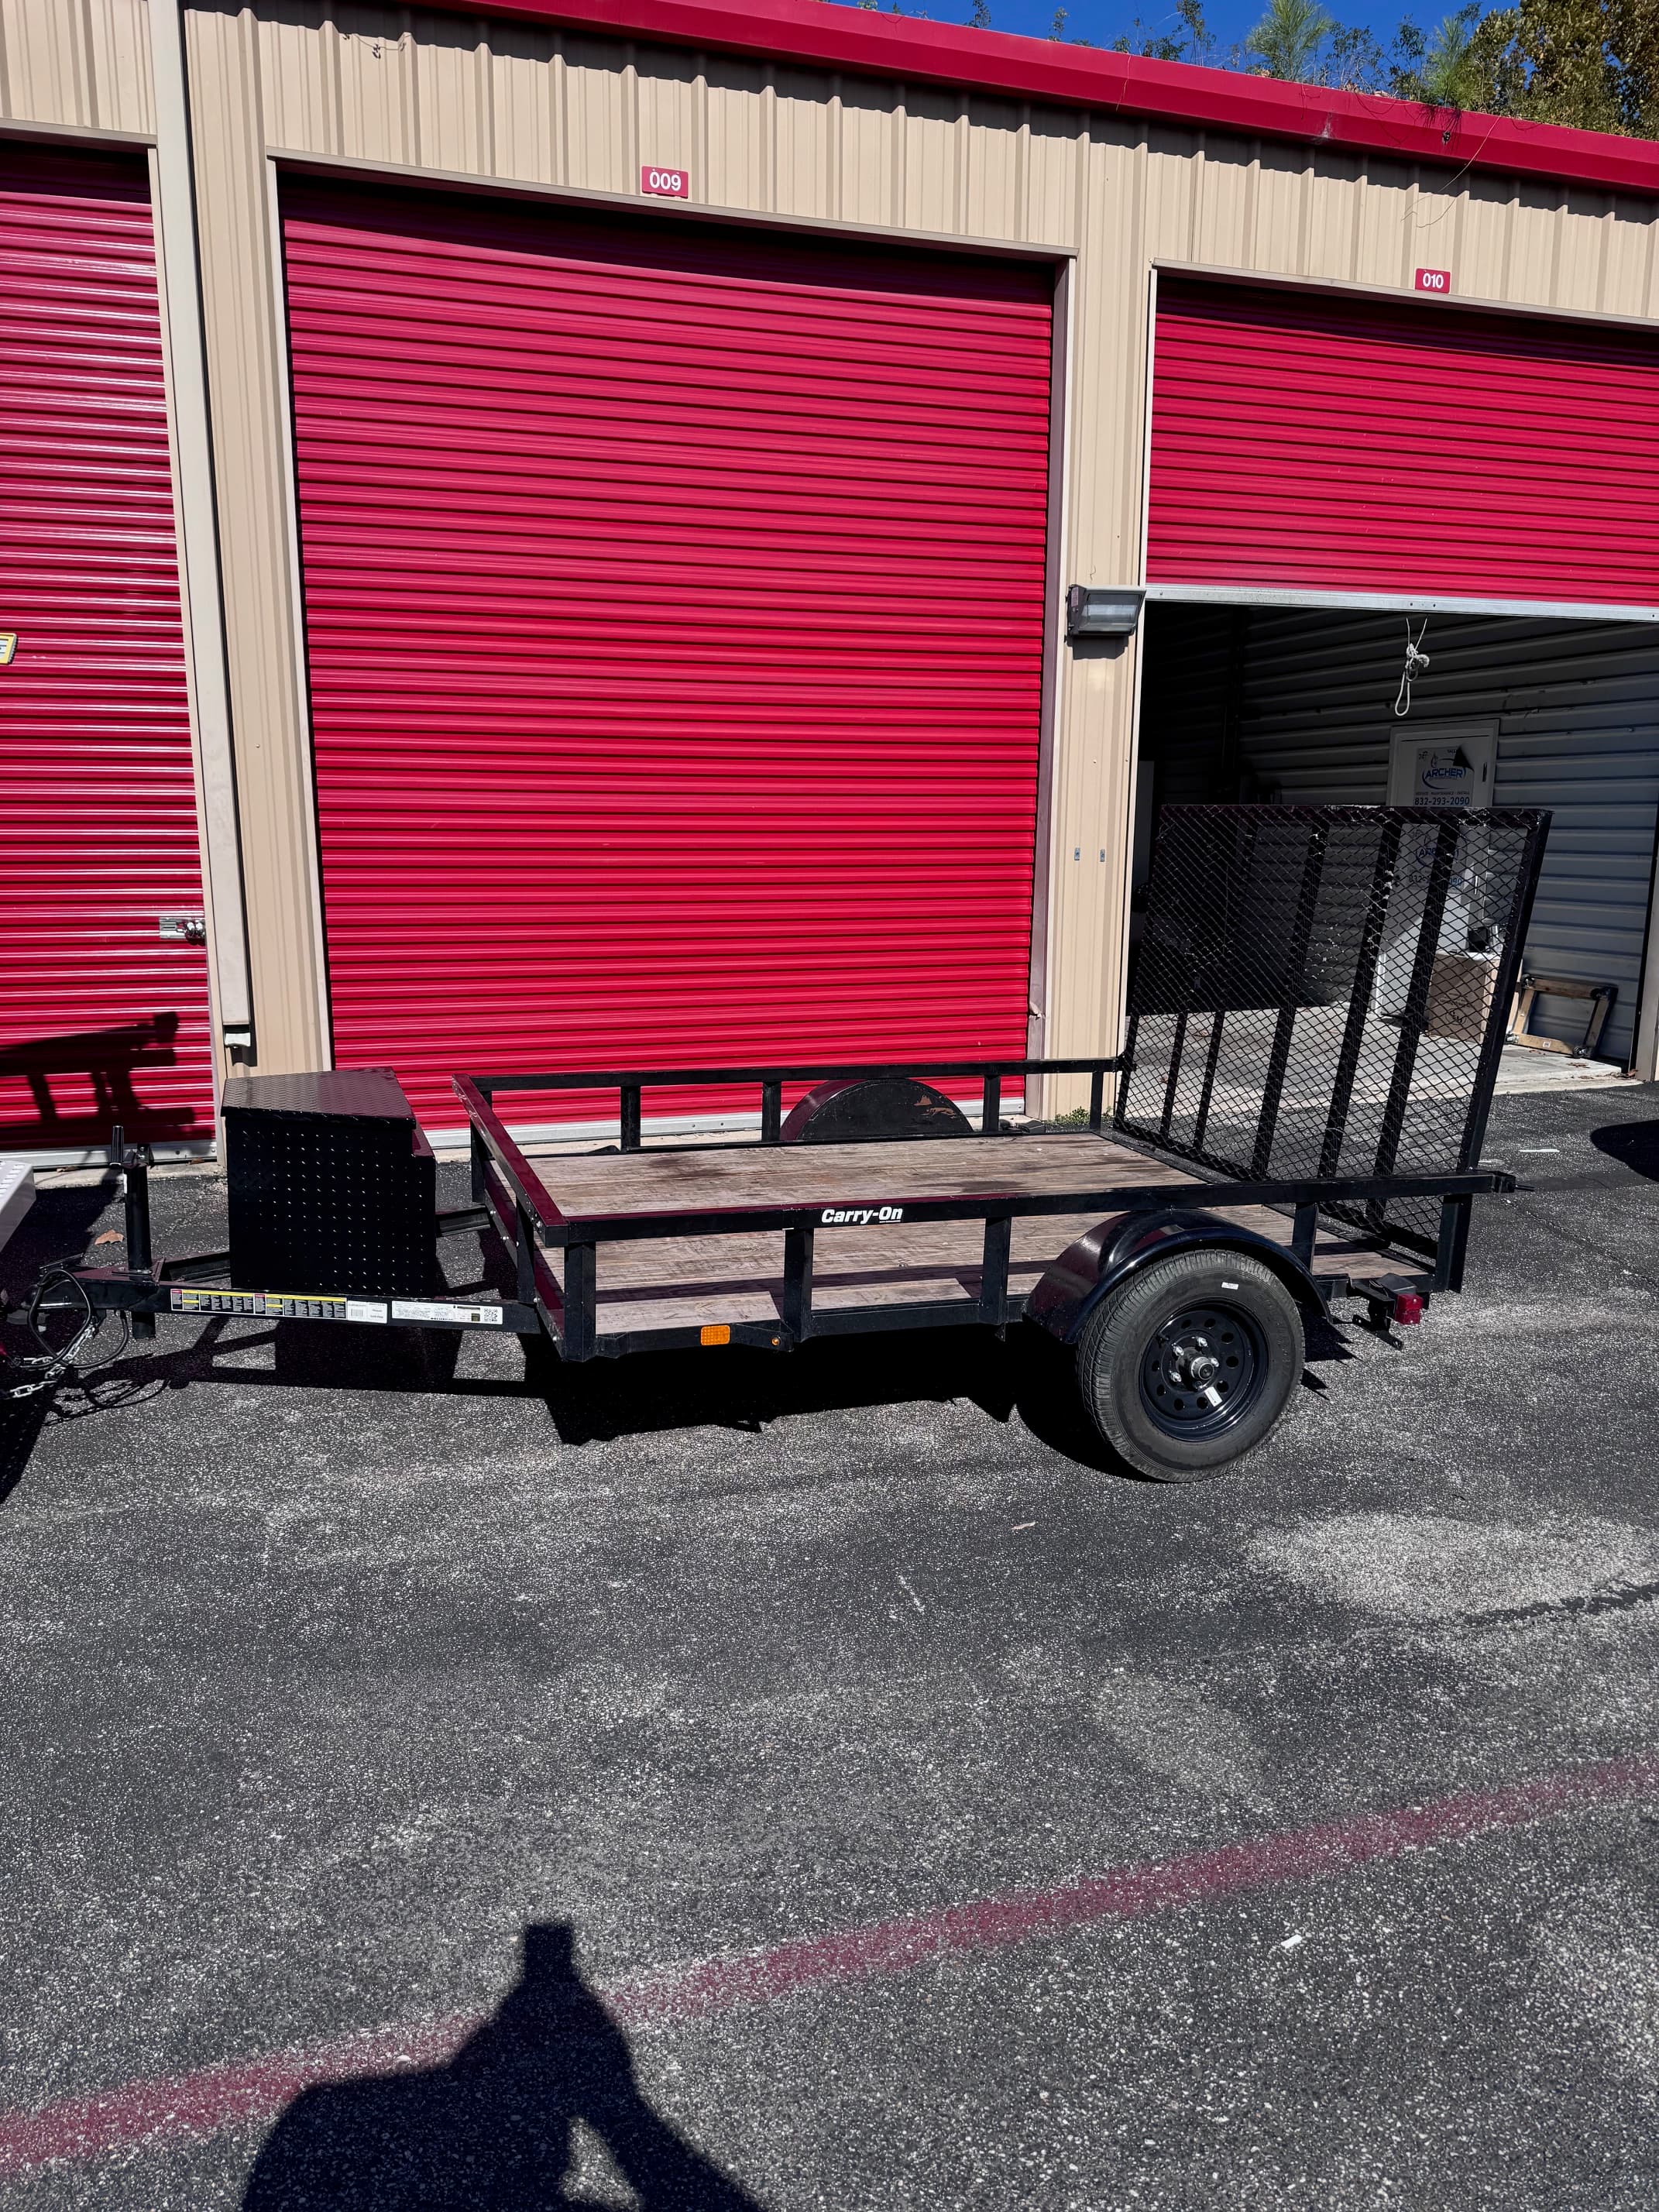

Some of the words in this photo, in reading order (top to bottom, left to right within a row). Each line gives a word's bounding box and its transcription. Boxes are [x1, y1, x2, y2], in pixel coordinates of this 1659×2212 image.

[649, 171, 682, 191] 009
[1422, 273, 1444, 289] 010
[1424, 768, 1463, 779] ARCHER
[1414, 796, 1470, 805] 832-293-2090
[821, 1206, 903, 1224] Carry-On
